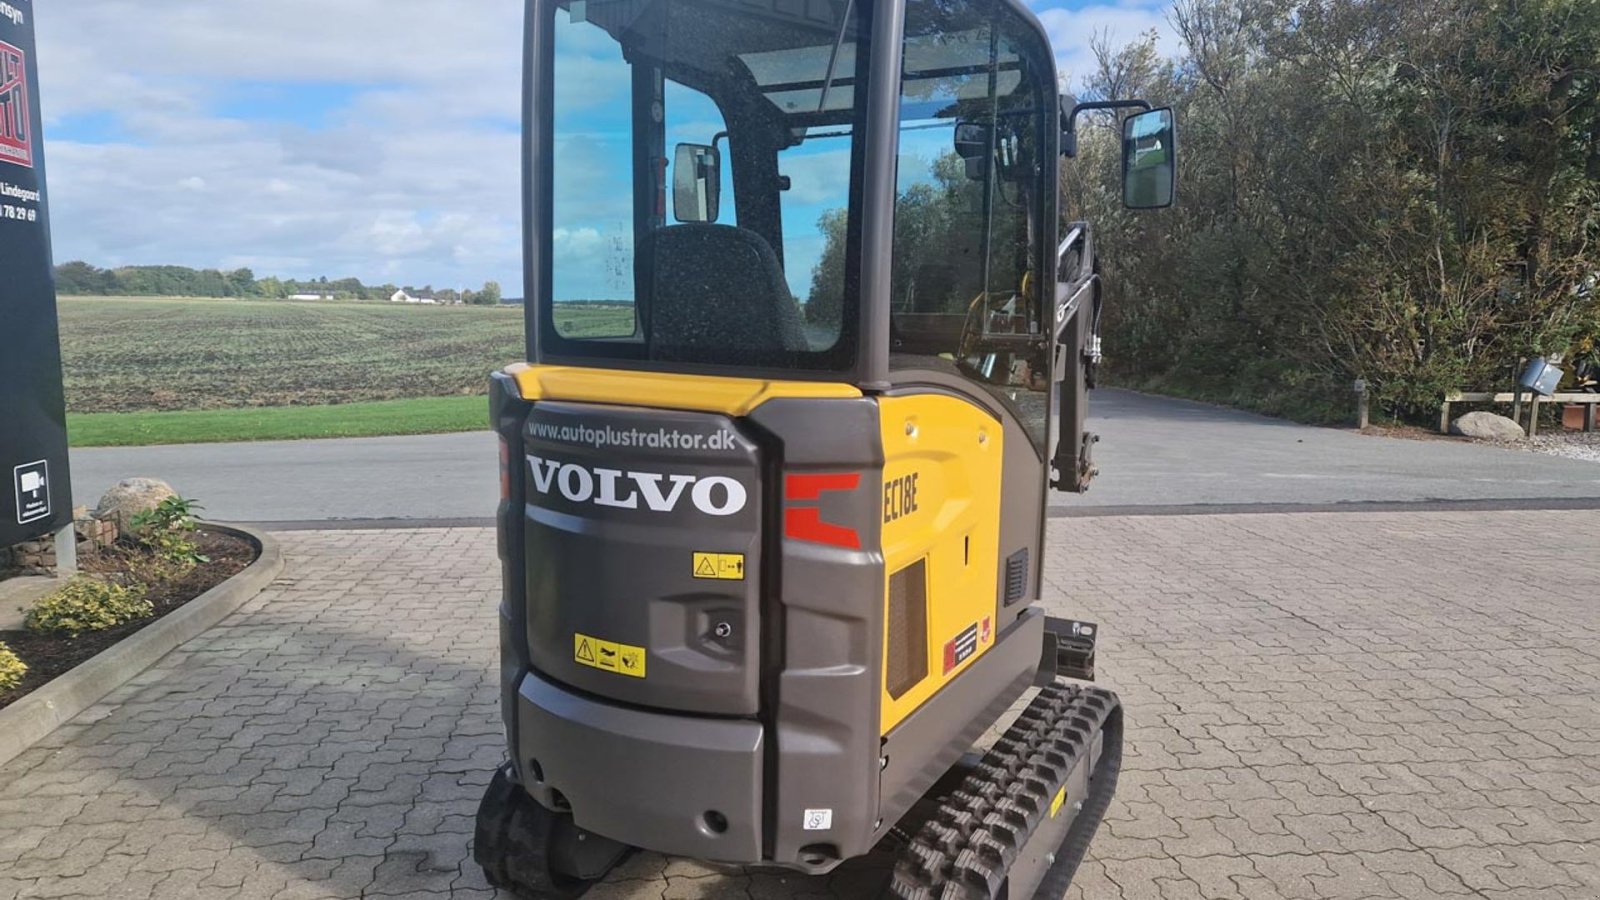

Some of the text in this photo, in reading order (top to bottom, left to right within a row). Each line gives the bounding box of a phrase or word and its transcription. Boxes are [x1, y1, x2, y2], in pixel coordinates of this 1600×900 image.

[0, 1, 24, 25] nsyn
[3, 204, 15, 219] 78
[16, 206, 26, 220] 29
[528, 421, 736, 450] www.autoplustraktor.dk
[526, 454, 747, 516] VOLVO
[884, 472, 918, 524] EC18E
